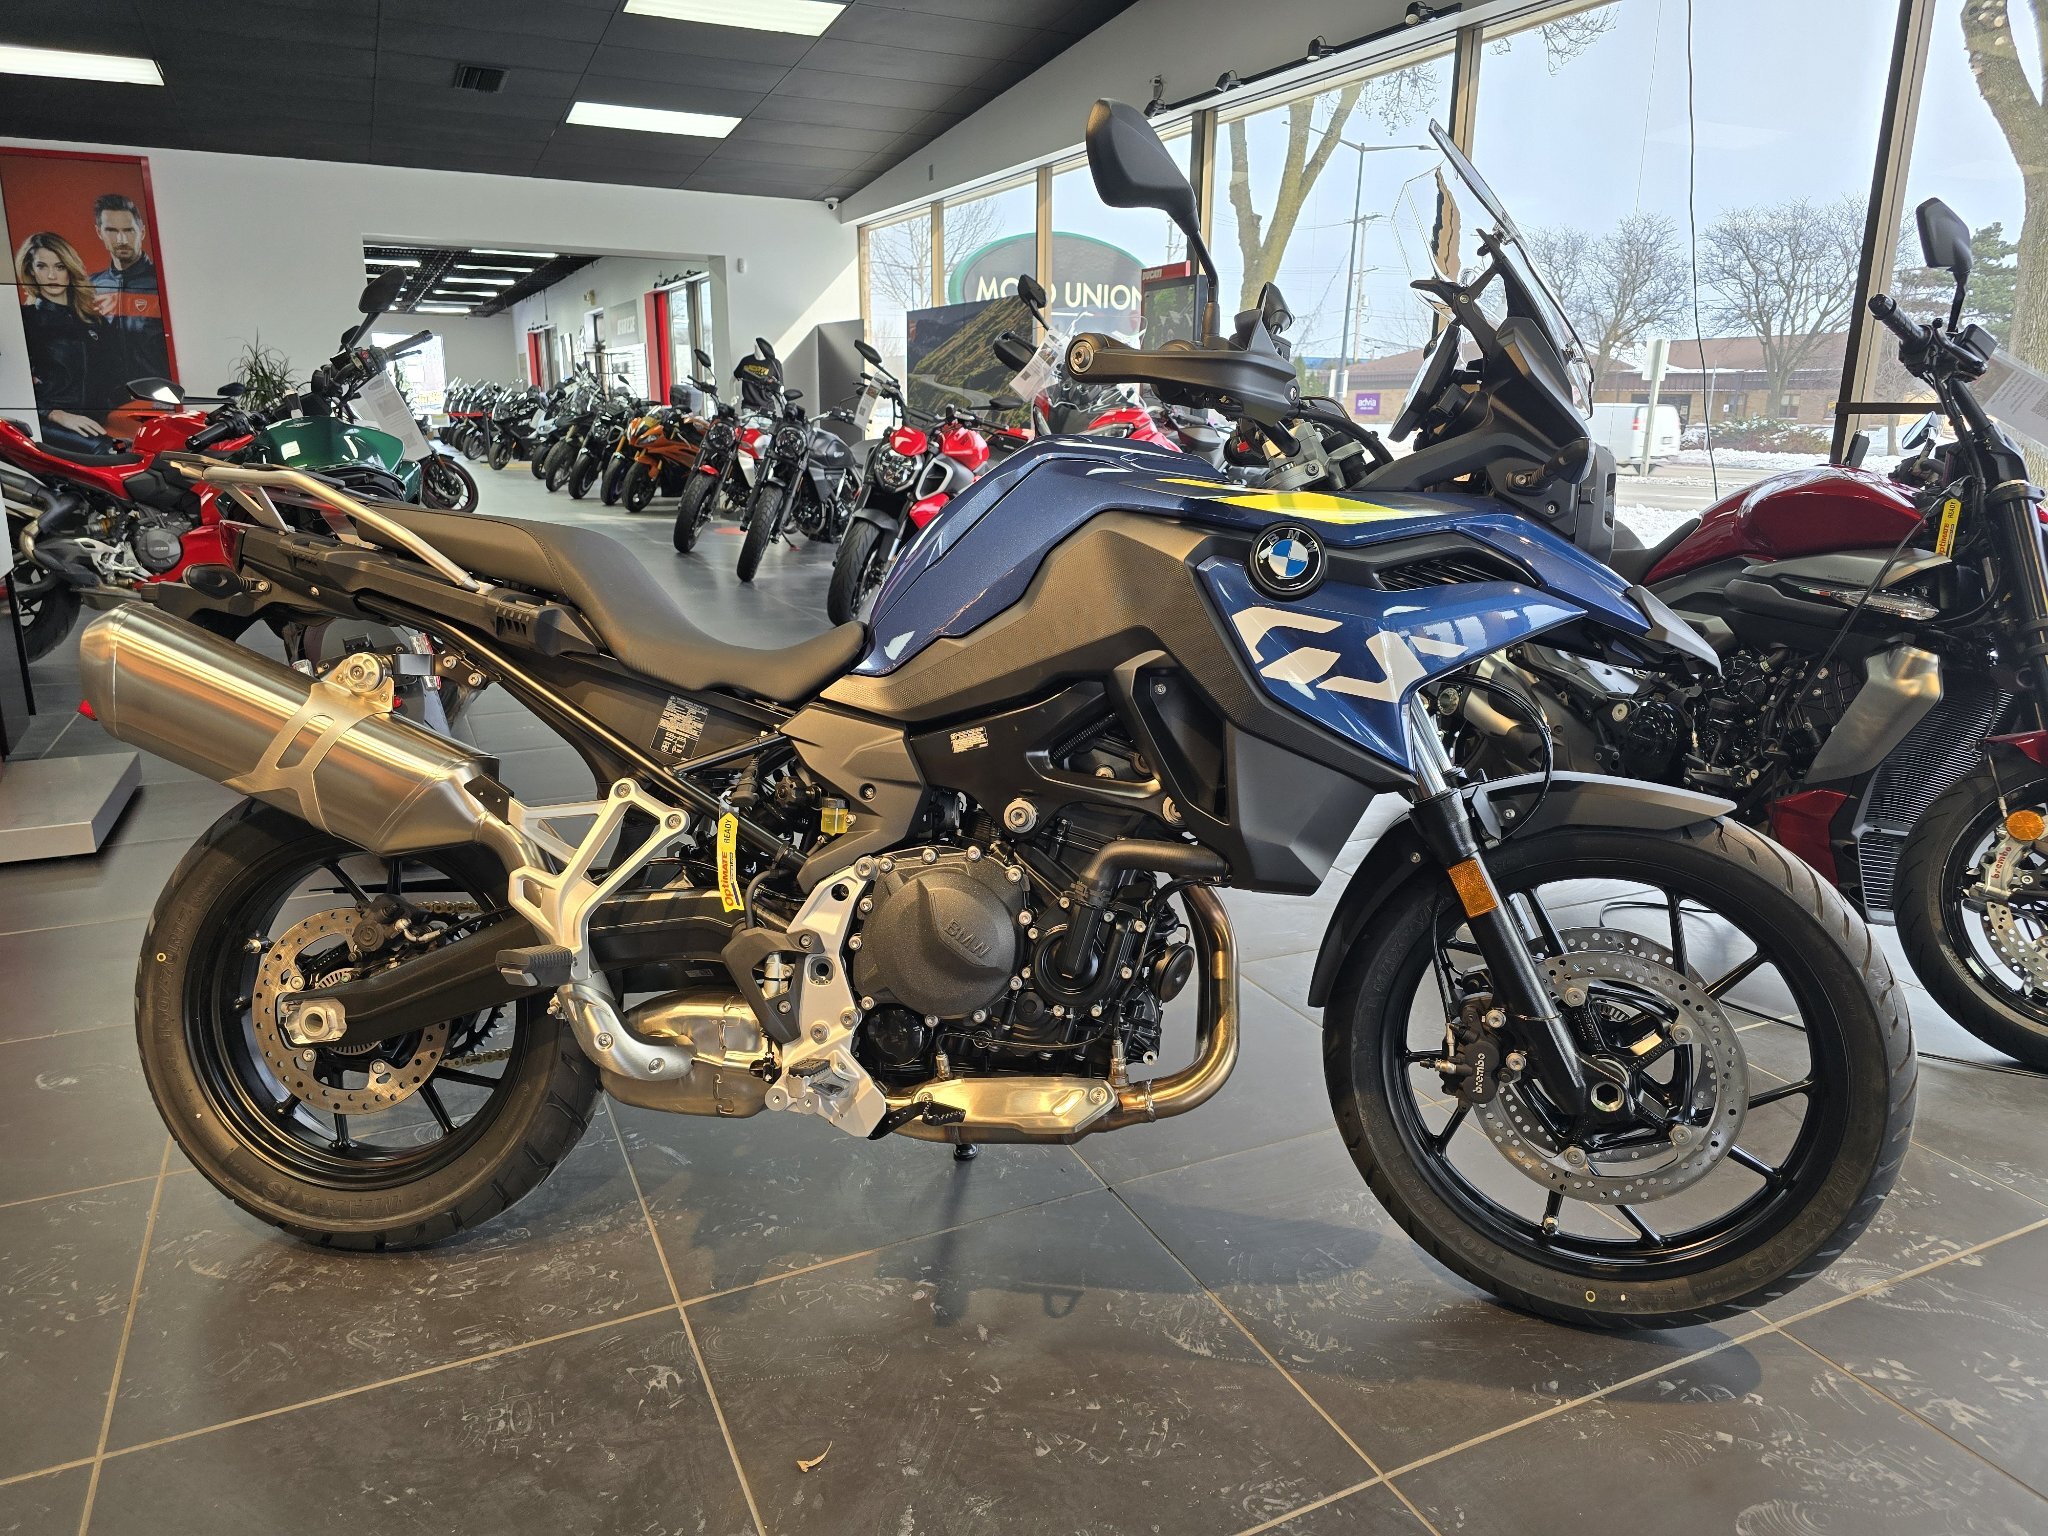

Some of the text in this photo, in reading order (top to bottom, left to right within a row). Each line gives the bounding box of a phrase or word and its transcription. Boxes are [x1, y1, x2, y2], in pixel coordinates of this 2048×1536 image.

[1266, 529, 1318, 554] BMW
[723, 818, 733, 844] READY
[1991, 846, 2012, 880] brembo
[943, 918, 993, 959] BMW
[1472, 1052, 1486, 1094] brembo
